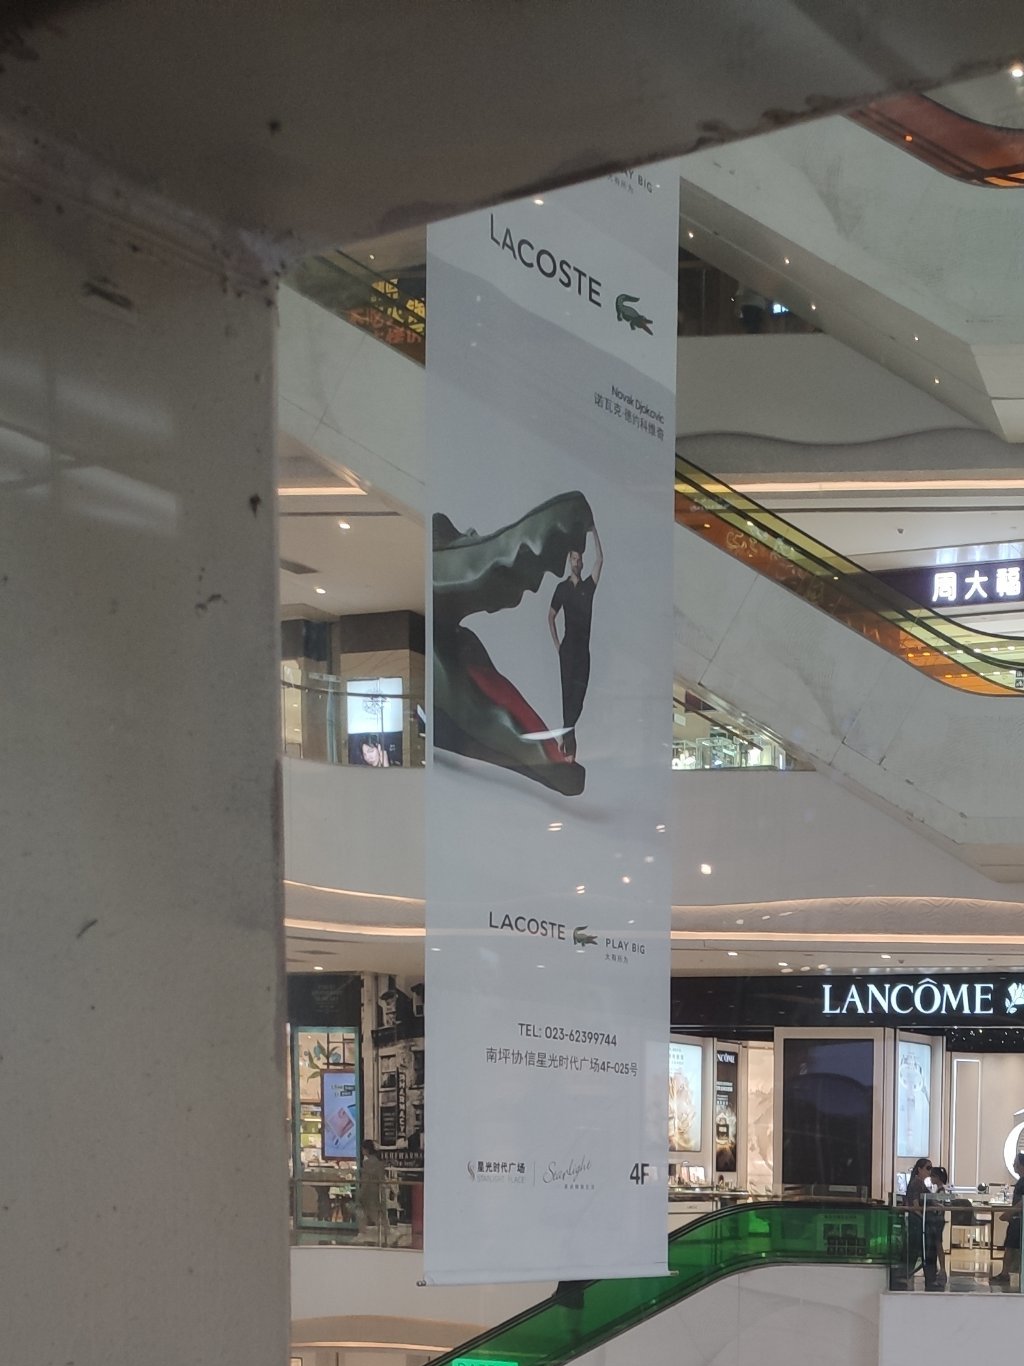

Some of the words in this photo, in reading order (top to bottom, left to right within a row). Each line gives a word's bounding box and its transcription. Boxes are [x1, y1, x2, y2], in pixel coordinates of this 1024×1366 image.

[490, 213, 602, 308] LACOSTE
[931, 566, 1022, 602] 周大福
[489, 911, 566, 941] LACOSTE
[605, 938, 629, 951] PLAY
[632, 943, 646, 955] BIG
[822, 977, 994, 1014] LANCÔME
[518, 1022, 542, 1038] TEL:
[545, 1026, 617, 1047] 023-62399744
[477, 1161, 526, 1174] 星光时代广场
[630, 1163, 650, 1185] 4F
